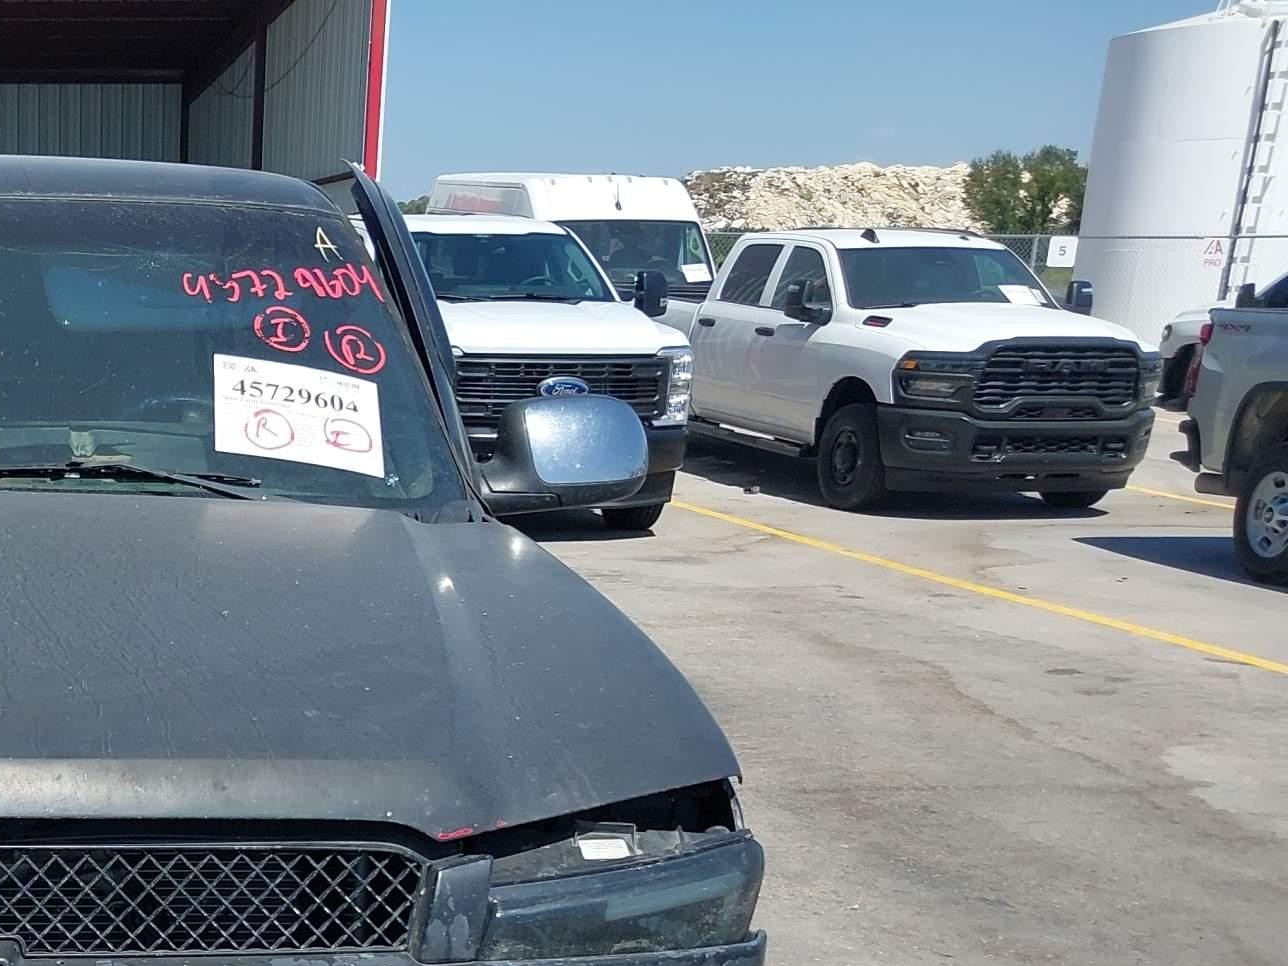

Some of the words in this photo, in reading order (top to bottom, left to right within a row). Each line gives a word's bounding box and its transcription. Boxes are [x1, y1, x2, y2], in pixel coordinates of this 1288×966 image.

[314, 226, 344, 263] A
[1058, 245, 1067, 256] 5
[232, 379, 360, 413] 45729604
[255, 416, 279, 438] R
